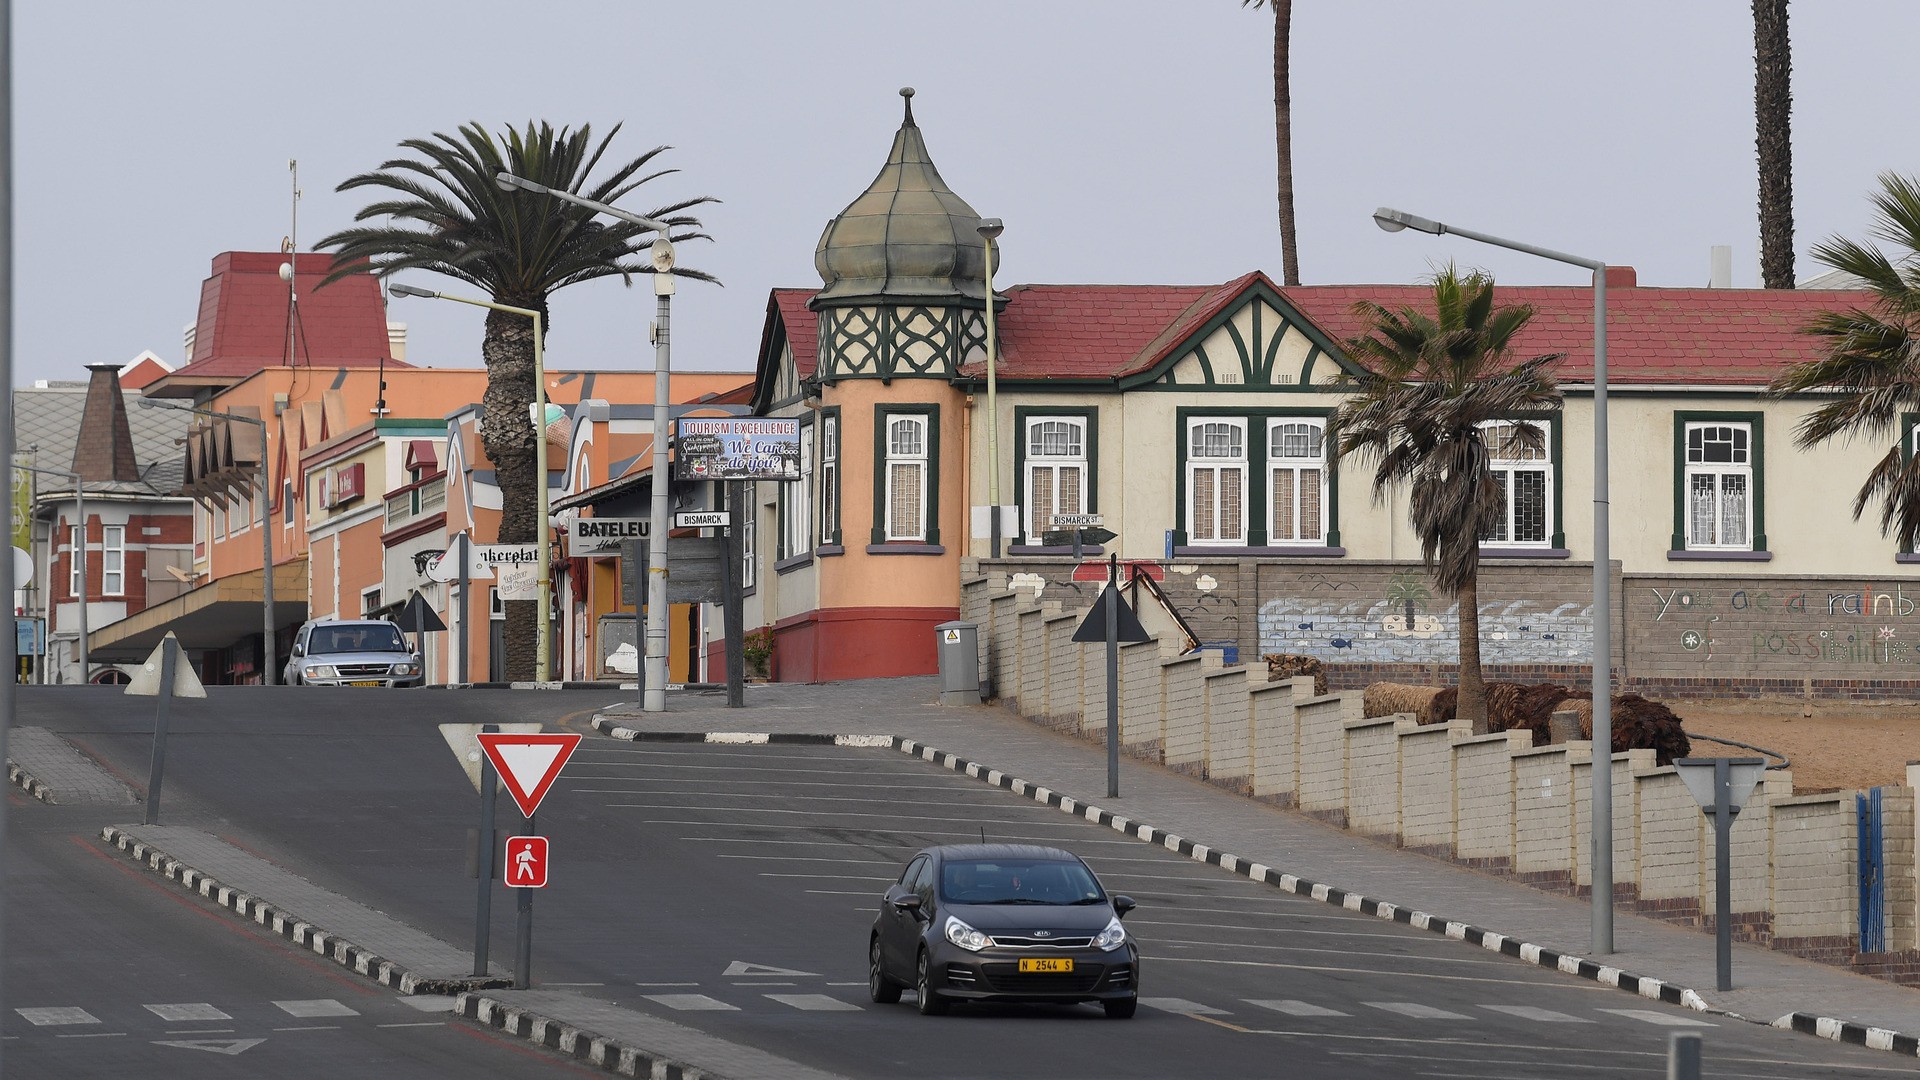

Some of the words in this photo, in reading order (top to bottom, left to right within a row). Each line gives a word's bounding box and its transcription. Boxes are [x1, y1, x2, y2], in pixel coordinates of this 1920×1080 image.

[683, 422, 730, 434] TOURISM
[734, 422, 795, 434] EXCELLENCE
[728, 440, 751, 454] We
[748, 456, 781, 472] you?
[684, 514, 722, 525] BISMARCK
[1054, 516, 1091, 525] BISMARCK
[579, 522, 651, 537] BATELEU
[1652, 588, 1712, 622] you
[1022, 960, 1028, 970] N
[1036, 960, 1057, 970] 2544
[1065, 960, 1070, 970] S
